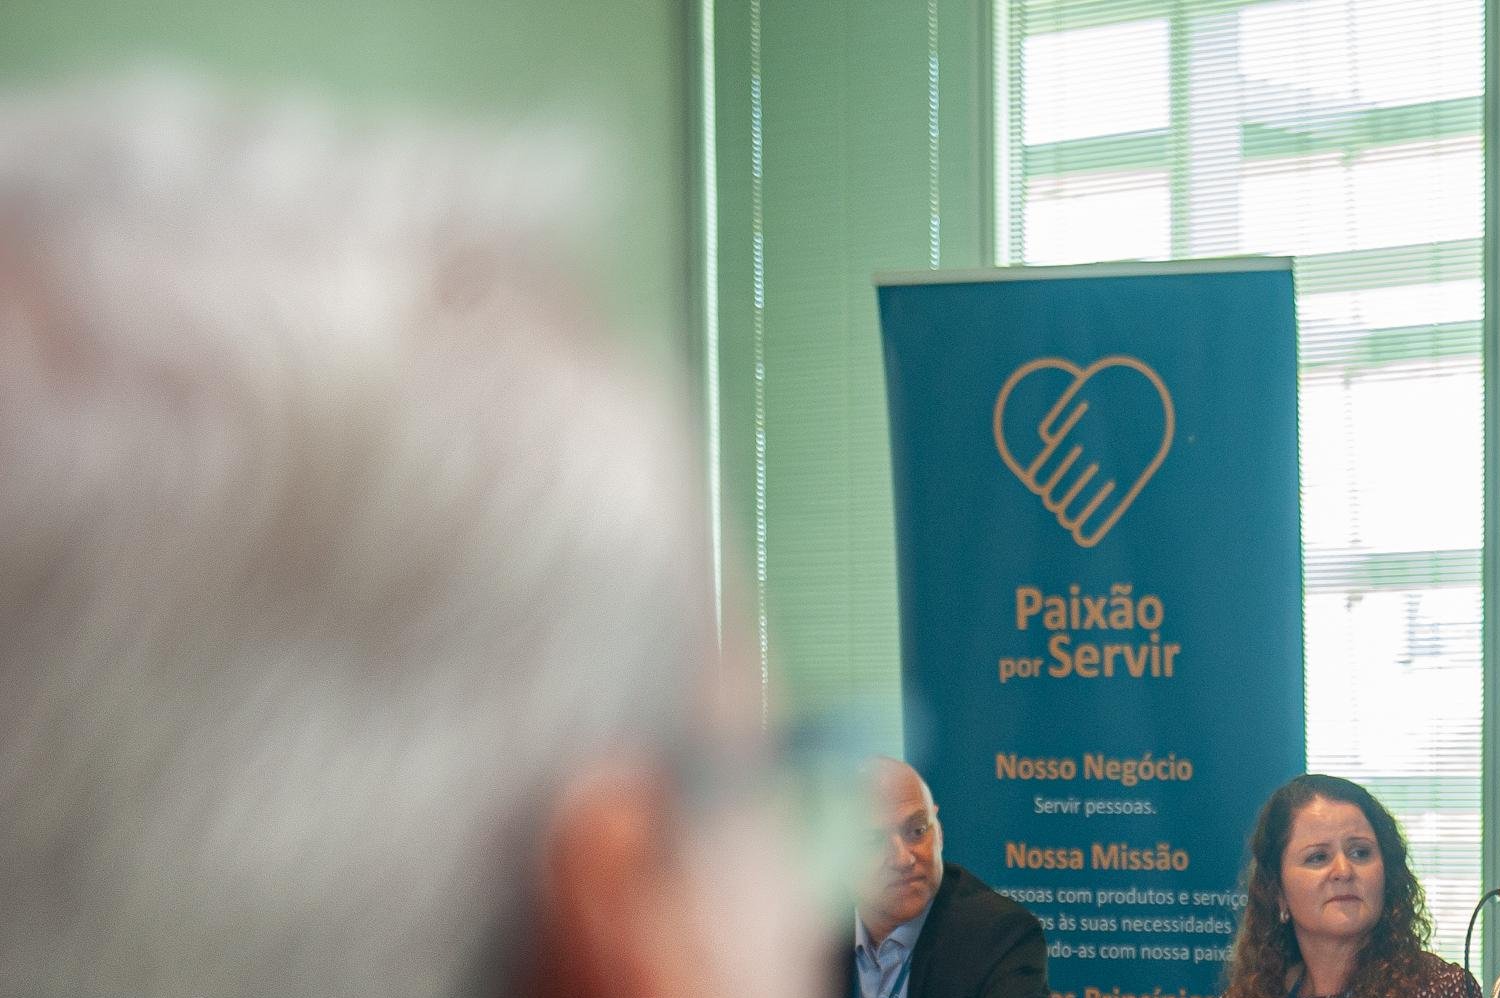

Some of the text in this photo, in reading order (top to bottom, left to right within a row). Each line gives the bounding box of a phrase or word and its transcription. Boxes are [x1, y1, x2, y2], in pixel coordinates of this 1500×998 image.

[1015, 583, 1164, 630] Paixão
[998, 633, 1181, 683] por Servir
[995, 753, 1194, 786] Nosso Negócio
[1034, 797, 1157, 817] Servir pessoas.
[1005, 842, 1189, 871] Nossa Missão
[996, 887, 1249, 910] essoas com produtos e serviço
[1059, 913, 1077, 931] às
[1080, 918, 1117, 931] suas
[1122, 916, 1232, 934] necessidades
[1100, 945, 1136, 959] com
[1141, 946, 1189, 960] nossa
